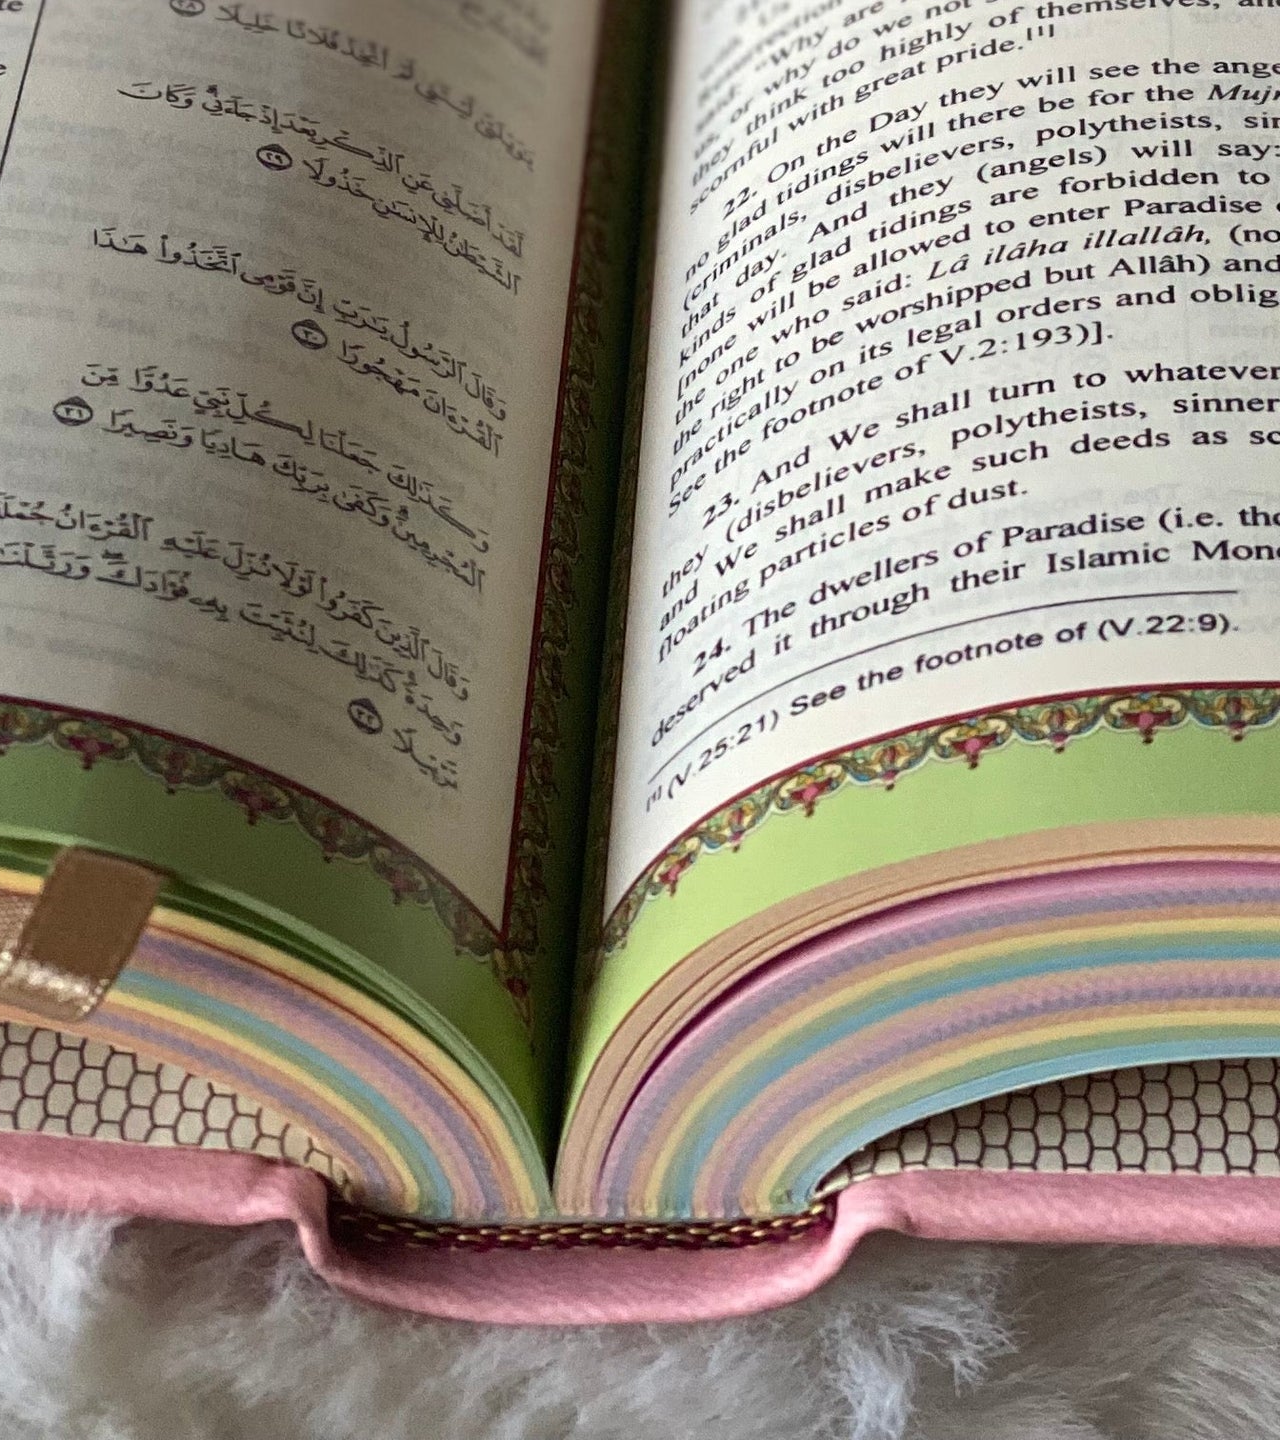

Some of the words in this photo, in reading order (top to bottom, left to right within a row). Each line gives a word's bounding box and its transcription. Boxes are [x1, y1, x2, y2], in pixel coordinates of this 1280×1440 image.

[669, 379, 799, 494] practically
[809, 359, 846, 386] on
[858, 340, 894, 366] its
[907, 308, 983, 348] legal
[995, 295, 1103, 324] orders
[1115, 283, 1177, 308] and
[676, 333, 738, 403] [none
[746, 289, 795, 333] will
[807, 273, 841, 299] be
[852, 222, 972, 279] allowed
[984, 219, 1016, 237] to
[1027, 205, 1111, 229] enter
[1123, 193, 1263, 218] Paradise
[658, 577, 699, 633] and
[713, 541, 759, 578] We
[774, 493, 846, 544] shall
[864, 464, 952, 505] make
[971, 439, 1050, 473] such
[1069, 426, 1172, 455] deeds
[1190, 429, 1229, 447] as
[661, 544, 709, 599] they
[725, 441, 927, 544] (disbelievers,
[951, 399, 1148, 451] polytheists,
[702, 491, 741, 531] 23.
[750, 444, 811, 495] And
[827, 422, 881, 452] We
[895, 388, 971, 429] shall
[987, 378, 1057, 404] turn
[1072, 371, 1108, 390] to
[650, 647, 756, 748] deserved
[774, 633, 793, 657] it
[809, 581, 931, 640] through
[949, 559, 1027, 594] their
[1046, 541, 1171, 575] Islamic
[658, 578, 751, 664] floating
[759, 514, 891, 589] particles
[901, 492, 942, 523] of
[946, 479, 1028, 511] dust.
[692, 636, 732, 678] 24.
[742, 600, 797, 638] The
[807, 549, 940, 607] dwellers
[952, 529, 994, 559] of
[1001, 511, 1146, 549] Paradise
[1157, 506, 1224, 535] (i.e.
[789, 684, 848, 717] See
[856, 665, 905, 692] the
[913, 632, 1045, 675] footnote
[1054, 620, 1089, 644] of
